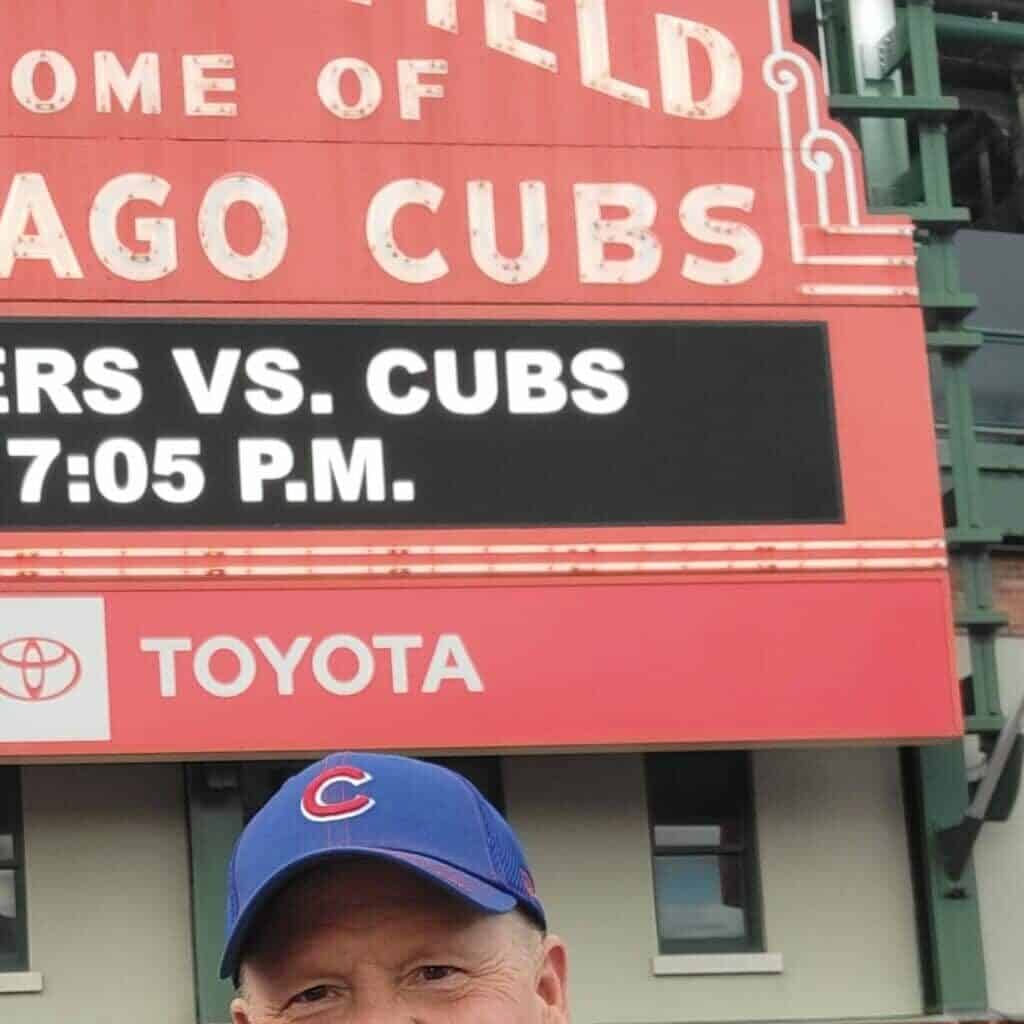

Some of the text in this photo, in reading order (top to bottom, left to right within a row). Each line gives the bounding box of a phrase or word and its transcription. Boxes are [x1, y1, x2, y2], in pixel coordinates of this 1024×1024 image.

[316, 57, 448, 120] OF
[346, 0, 743, 120] ELD
[365, 178, 763, 285] CUBS
[171, 347, 334, 416] VS.
[365, 347, 630, 416] CUBS
[6, 437, 415, 504] 7:05 P.M.
[140, 633, 484, 698] TOYOTA
[300, 764, 375, 822] C
